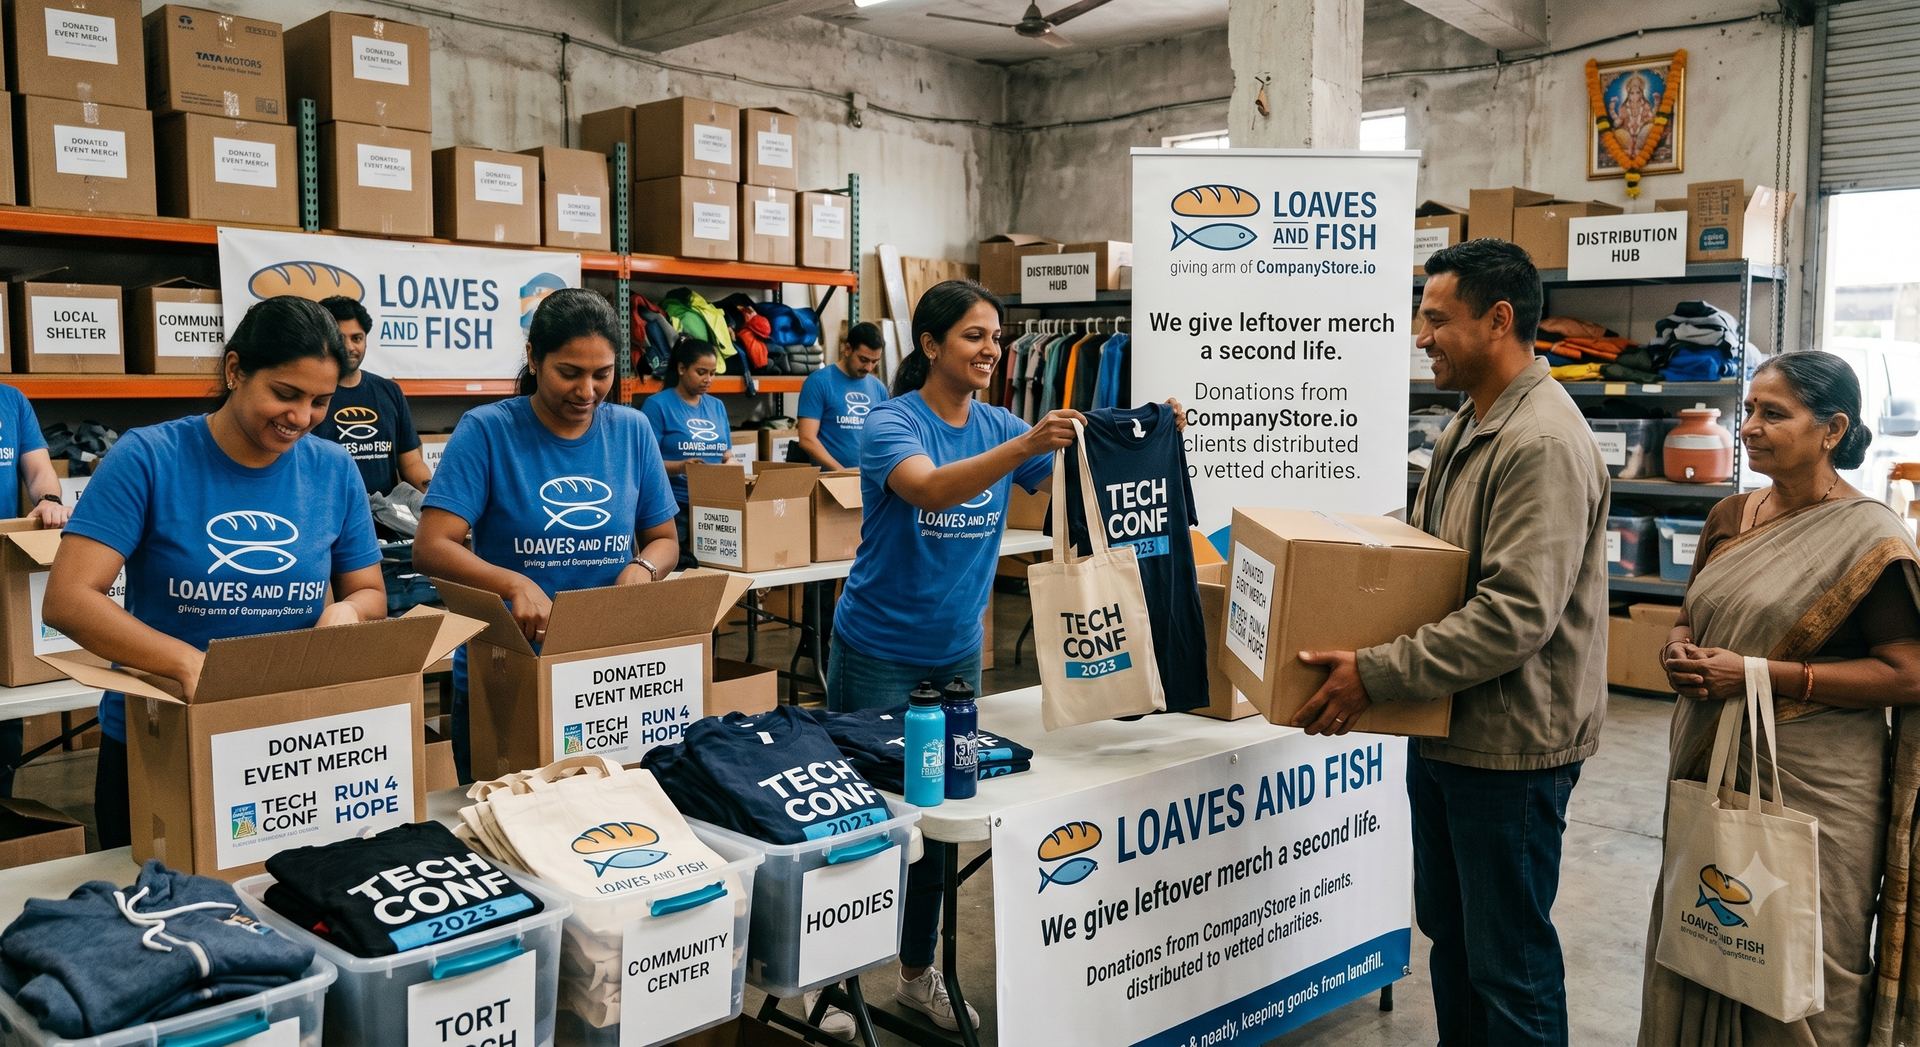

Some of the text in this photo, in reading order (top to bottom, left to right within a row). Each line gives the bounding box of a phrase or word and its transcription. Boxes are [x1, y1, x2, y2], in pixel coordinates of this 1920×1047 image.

[54, 29, 108, 43] EVENT MERCH
[62, 21, 99, 33] DONATED
[195, 51, 222, 63] TATA
[224, 55, 262, 69] MOTORS
[63, 145, 118, 157] EVENT MERCH
[71, 137, 108, 147] DONATED
[228, 149, 261, 159] DONATED
[1274, 191, 1377, 218] LOAVES
[1273, 223, 1376, 250] AND FISH
[1576, 227, 1678, 246] DISTRIBUTION
[1611, 248, 1640, 263] HUB
[1026, 264, 1089, 277] DISTRIBUTION
[1170, 260, 1376, 278] giving arm of CompanyStore.io
[379, 273, 499, 311] LOAVES
[1049, 280, 1068, 291] HUB
[53, 310, 98, 323] LOCAL
[159, 314, 224, 327] COMMUNI
[1149, 312, 1395, 337] We give leftover merch
[46, 327, 106, 340] SHELTER
[175, 331, 224, 342] CENTER
[380, 316, 493, 350] AND FISH
[1200, 341, 1342, 360] a second life.
[1195, 382, 1348, 401] Donations from
[1185, 408, 1358, 431] CompanyStore.io
[0, 447, 14, 459] ISH
[359, 441, 392, 452] AND FISH
[678, 441, 705, 451] LOAVES
[1183, 434, 1358, 453] clients distributed
[1204, 460, 1264, 479] vetted
[1270, 460, 1361, 479] charities.
[1106, 477, 1167, 511] TECH
[703, 512, 729, 523] DONATED
[917, 508, 1001, 528] LOAVES AND FIS
[1108, 507, 1168, 539] CONF
[514, 534, 631, 555] LOAVES AND FISH
[1135, 541, 1155, 555] 023
[562, 558, 570, 567] of
[1241, 558, 1264, 585] DONATED
[169, 577, 325, 601] LOAVES AND FISH
[178, 604, 206, 616] giving
[229, 606, 240, 615] of
[1060, 603, 1123, 635] TECH
[1063, 627, 1127, 660] CONF
[1247, 632, 1264, 661] HOPE
[593, 661, 666, 685] DONATED
[1081, 658, 1117, 677] 2023
[575, 678, 683, 709] EVENT MERCH
[585, 704, 690, 735] TECH RUN 4
[268, 726, 365, 757] DONATED
[586, 722, 690, 750] CONF HOPE
[244, 745, 388, 786] EVENT MERCH
[757, 757, 861, 799] TECH
[262, 790, 317, 815] TECH
[334, 778, 379, 802] RUN
[385, 775, 398, 790] 4
[785, 782, 877, 822] CONF
[1117, 743, 1383, 864] LOAVES AND FISH
[262, 808, 318, 833] CONF
[335, 795, 399, 824] HOPE
[826, 812, 874, 837] 2023
[346, 852, 492, 901] TECH
[596, 861, 708, 895] LOAVES AND FISH
[1041, 810, 1381, 947] We give leftover merch a second life.
[373, 871, 510, 925] CONF
[428, 905, 498, 938] 2023
[806, 889, 894, 934] HOODIES
[1087, 872, 1354, 987] Donations from CompanyStore in clients.
[1681, 910, 1719, 937] LOAVES
[1736, 938, 1765, 955] FISH
[628, 933, 728, 977] COMMUNITY
[1126, 910, 1322, 1001] distributed to vetted charities.
[647, 961, 710, 994] CENTER
[1189, 1035, 1197, 1047] &
[1242, 1000, 1284, 1031] keeping
[1321, 973, 1345, 995] from
[1347, 950, 1384, 981] landfill.
[435, 998, 511, 1042] TORT
